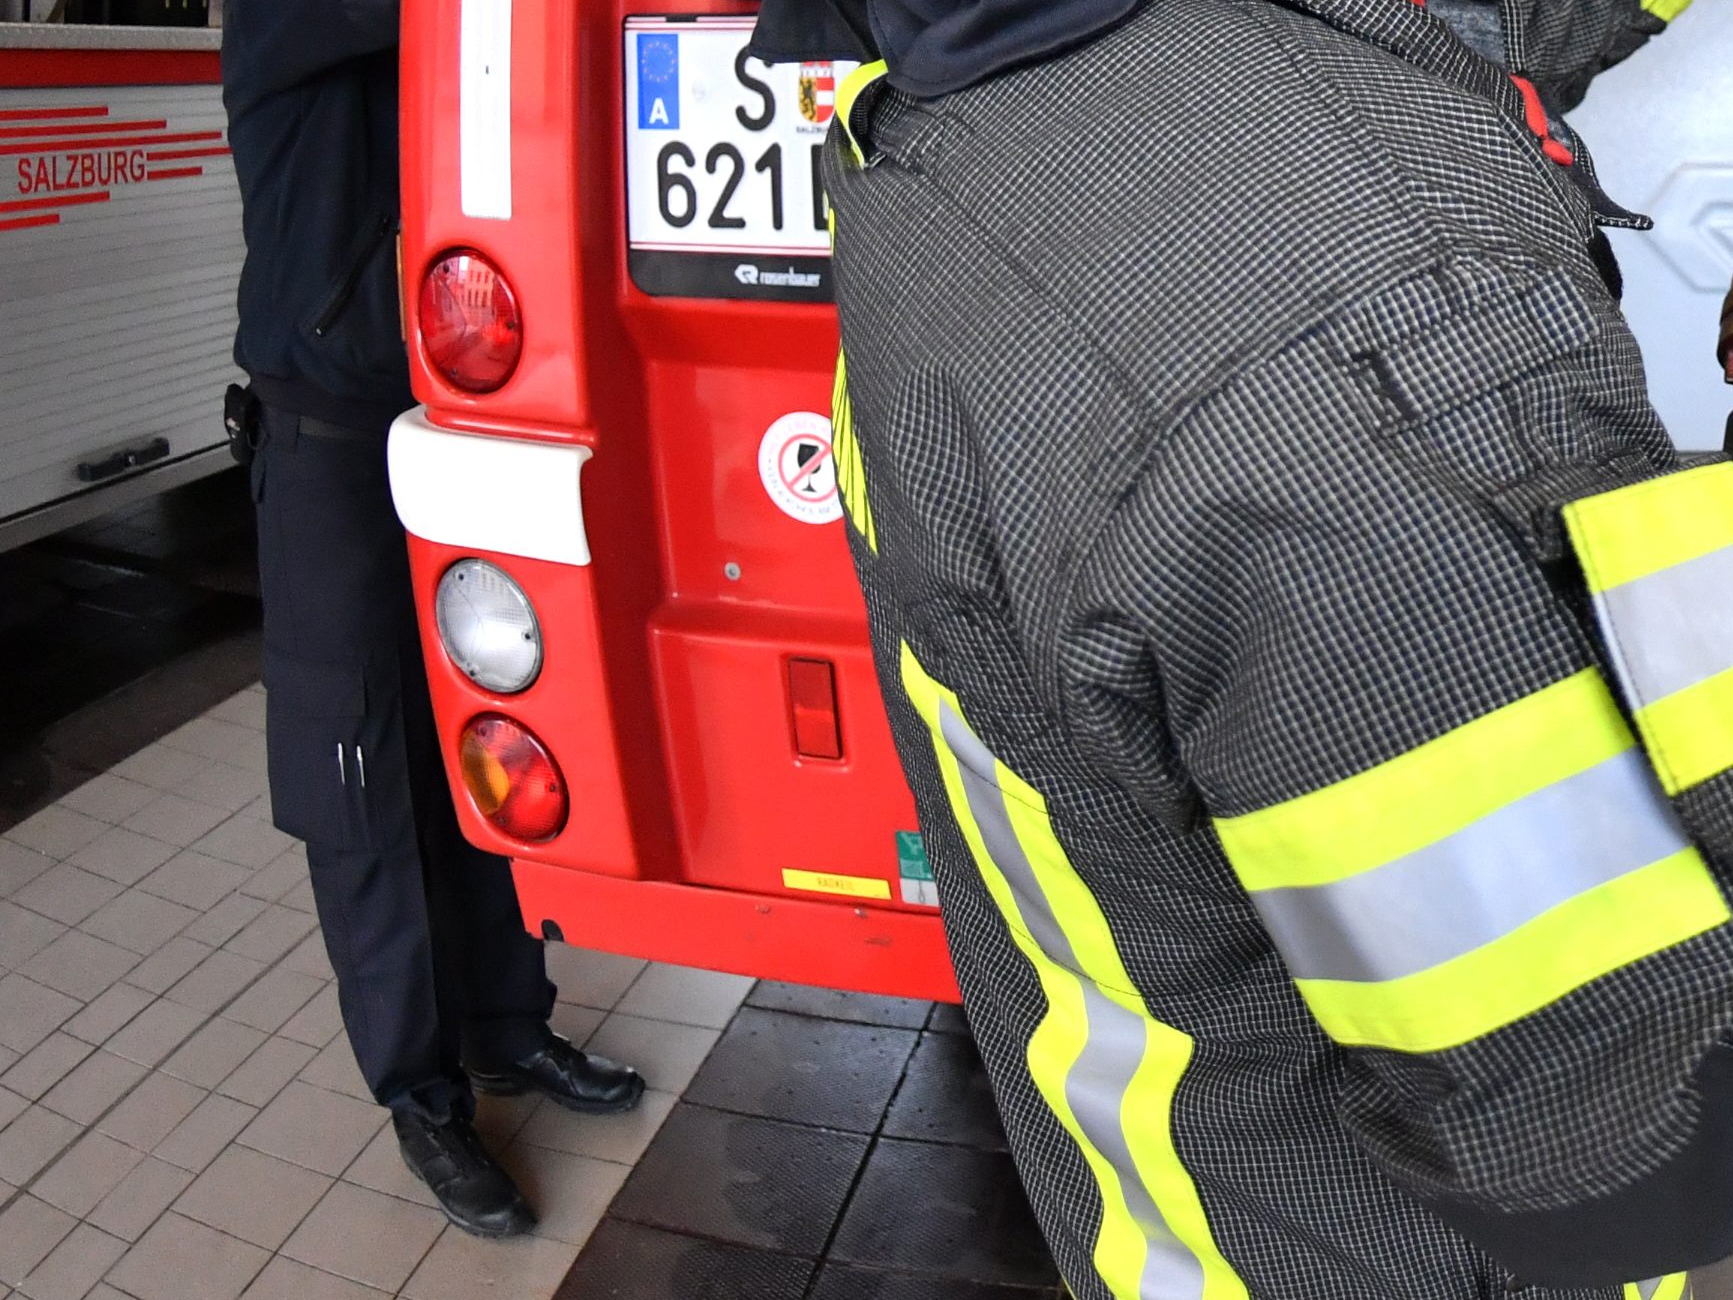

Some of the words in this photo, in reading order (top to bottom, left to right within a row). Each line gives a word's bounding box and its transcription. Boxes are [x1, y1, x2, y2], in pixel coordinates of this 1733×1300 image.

[734, 44, 776, 132] S
[649, 98, 669, 124] A
[18, 149, 145, 194] SALZBURG
